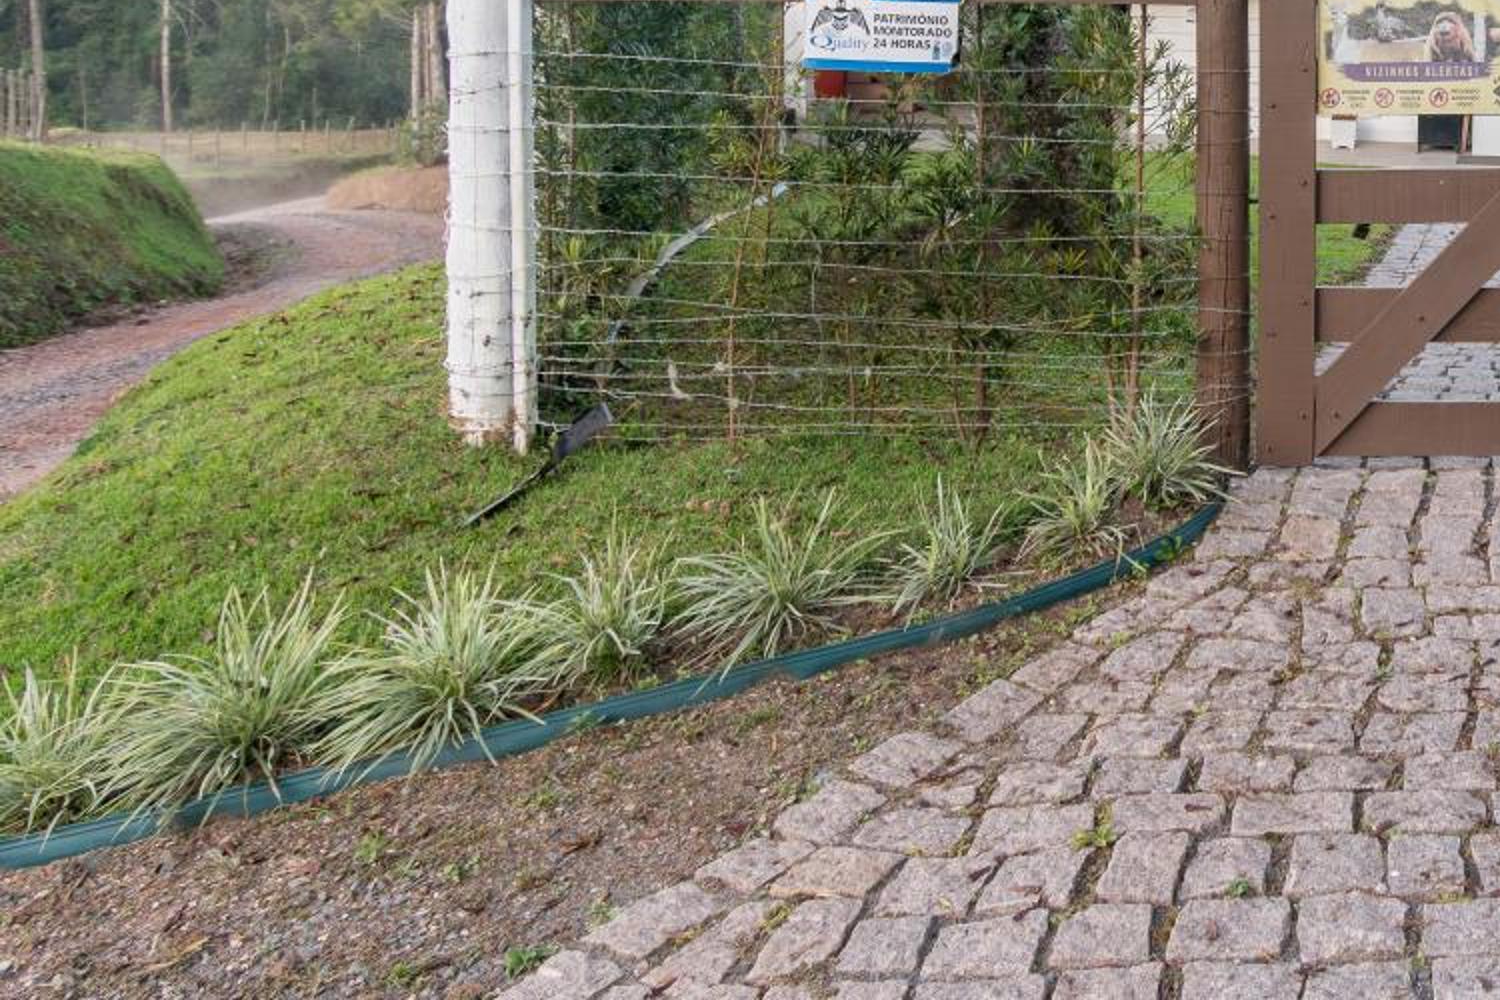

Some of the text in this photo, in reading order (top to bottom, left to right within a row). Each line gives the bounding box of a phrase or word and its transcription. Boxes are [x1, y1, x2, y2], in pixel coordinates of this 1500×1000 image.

[873, 25, 953, 38] MONITORADO
[873, 37, 932, 50] 24 HORAS
